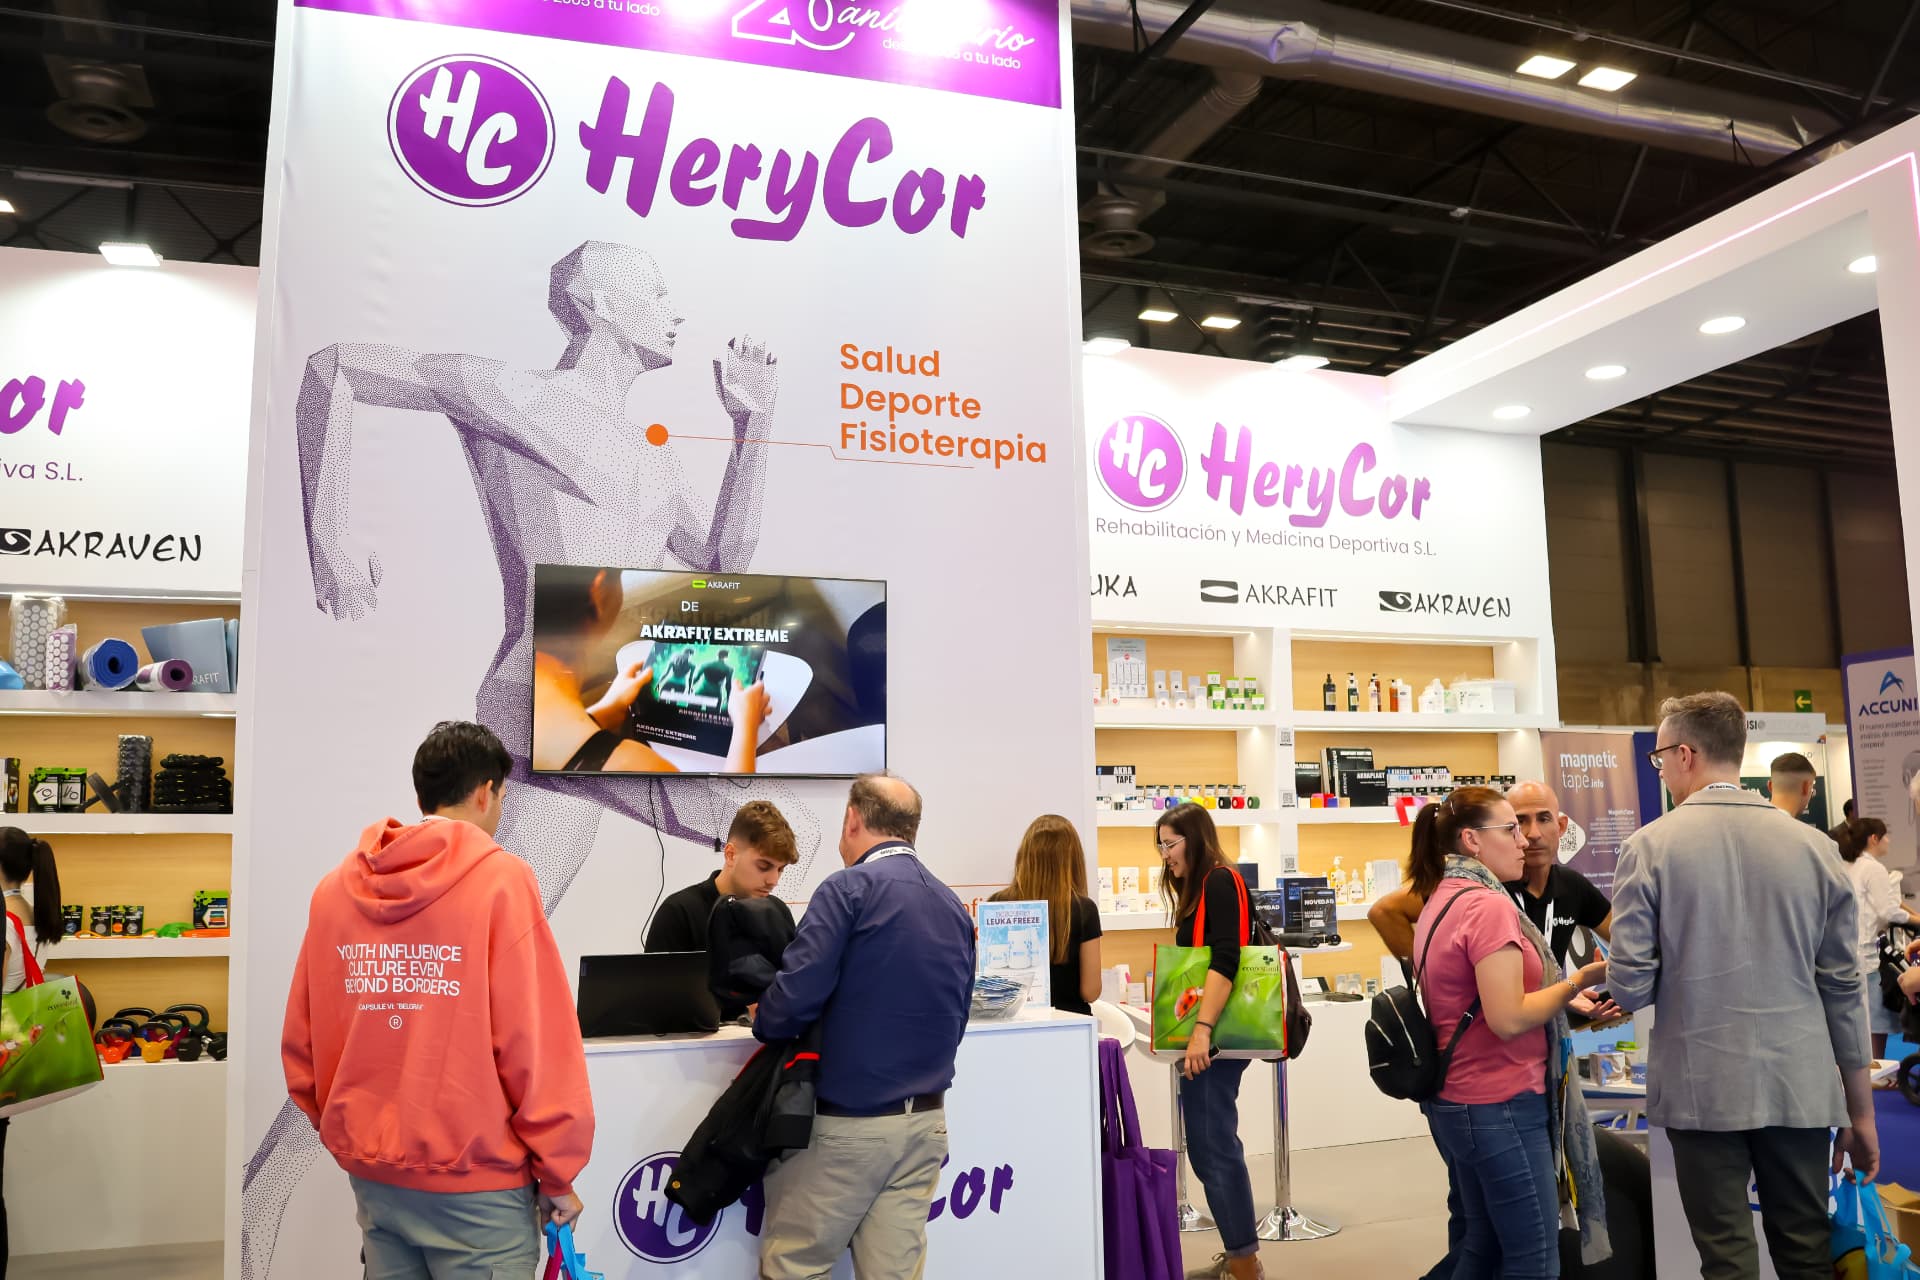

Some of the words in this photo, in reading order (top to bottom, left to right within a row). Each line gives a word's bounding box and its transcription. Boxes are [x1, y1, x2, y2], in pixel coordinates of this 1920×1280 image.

[608, 0, 622, 11] tu
[627, 0, 660, 16] lado
[975, 52, 989, 64] tu
[991, 53, 1021, 69] lado
[419, 65, 518, 186] HC
[579, 75, 986, 241] HeryCor
[840, 343, 940, 377] Salud
[840, 382, 981, 421] Deporte
[840, 421, 1046, 469] Fisioterapia
[1109, 418, 1167, 499] HC
[45, 461, 83, 481] S.L.
[1200, 421, 1431, 528] HeryCor
[34, 530, 201, 562] AKRAVEN
[1096, 516, 1226, 543] Rehabilitación
[1231, 530, 1240, 547] y
[1246, 528, 1324, 549] Medicina
[1329, 534, 1409, 556] Deportiva
[1413, 540, 1437, 556] S.L.
[707, 580, 741, 590] AKRAFIT
[681, 600, 700, 612] DE
[1246, 584, 1338, 608] AKRAFIT
[1413, 592, 1511, 618] AKRAVEN
[640, 625, 713, 640] AKRAFIT
[714, 627, 789, 643] EXTREME
[1113, 766, 1133, 775] AKRA
[1560, 750, 1618, 771] magnetic
[1116, 775, 1133, 784] TAPE
[1304, 898, 1334, 906] NOVEDAD
[986, 917, 1012, 926] LEUKA
[1013, 916, 1041, 925] FREEZE
[336, 943, 377, 961] YOUTH
[379, 944, 462, 962] INFLUENCE
[348, 960, 406, 977] CULTURE
[410, 961, 444, 978] EVEN
[345, 977, 388, 994] BEYOND
[392, 977, 460, 997] BORDERS
